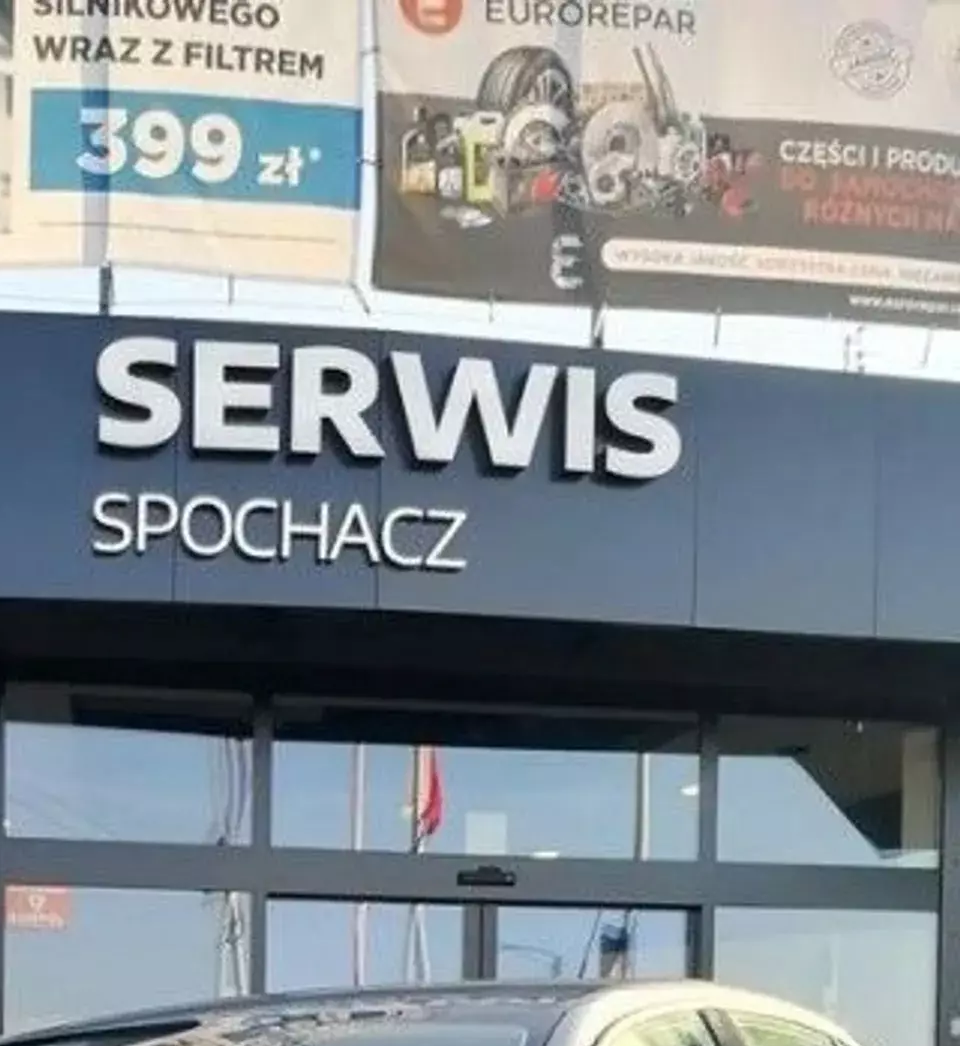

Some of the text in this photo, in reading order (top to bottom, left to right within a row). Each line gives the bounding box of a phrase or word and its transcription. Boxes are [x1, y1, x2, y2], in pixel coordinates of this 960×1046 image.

[33, 0, 280, 29] SILNIKOWEGO
[485, 0, 697, 34] EUROREPAR
[33, 35, 325, 80] WRAZ Z FILTREM
[76, 107, 243, 184] 399
[778, 137, 867, 169] CZĘŚCI
[871, 144, 880, 169] I
[95, 336, 683, 479] SERWIS
[92, 492, 468, 570] SPOCHACZ
